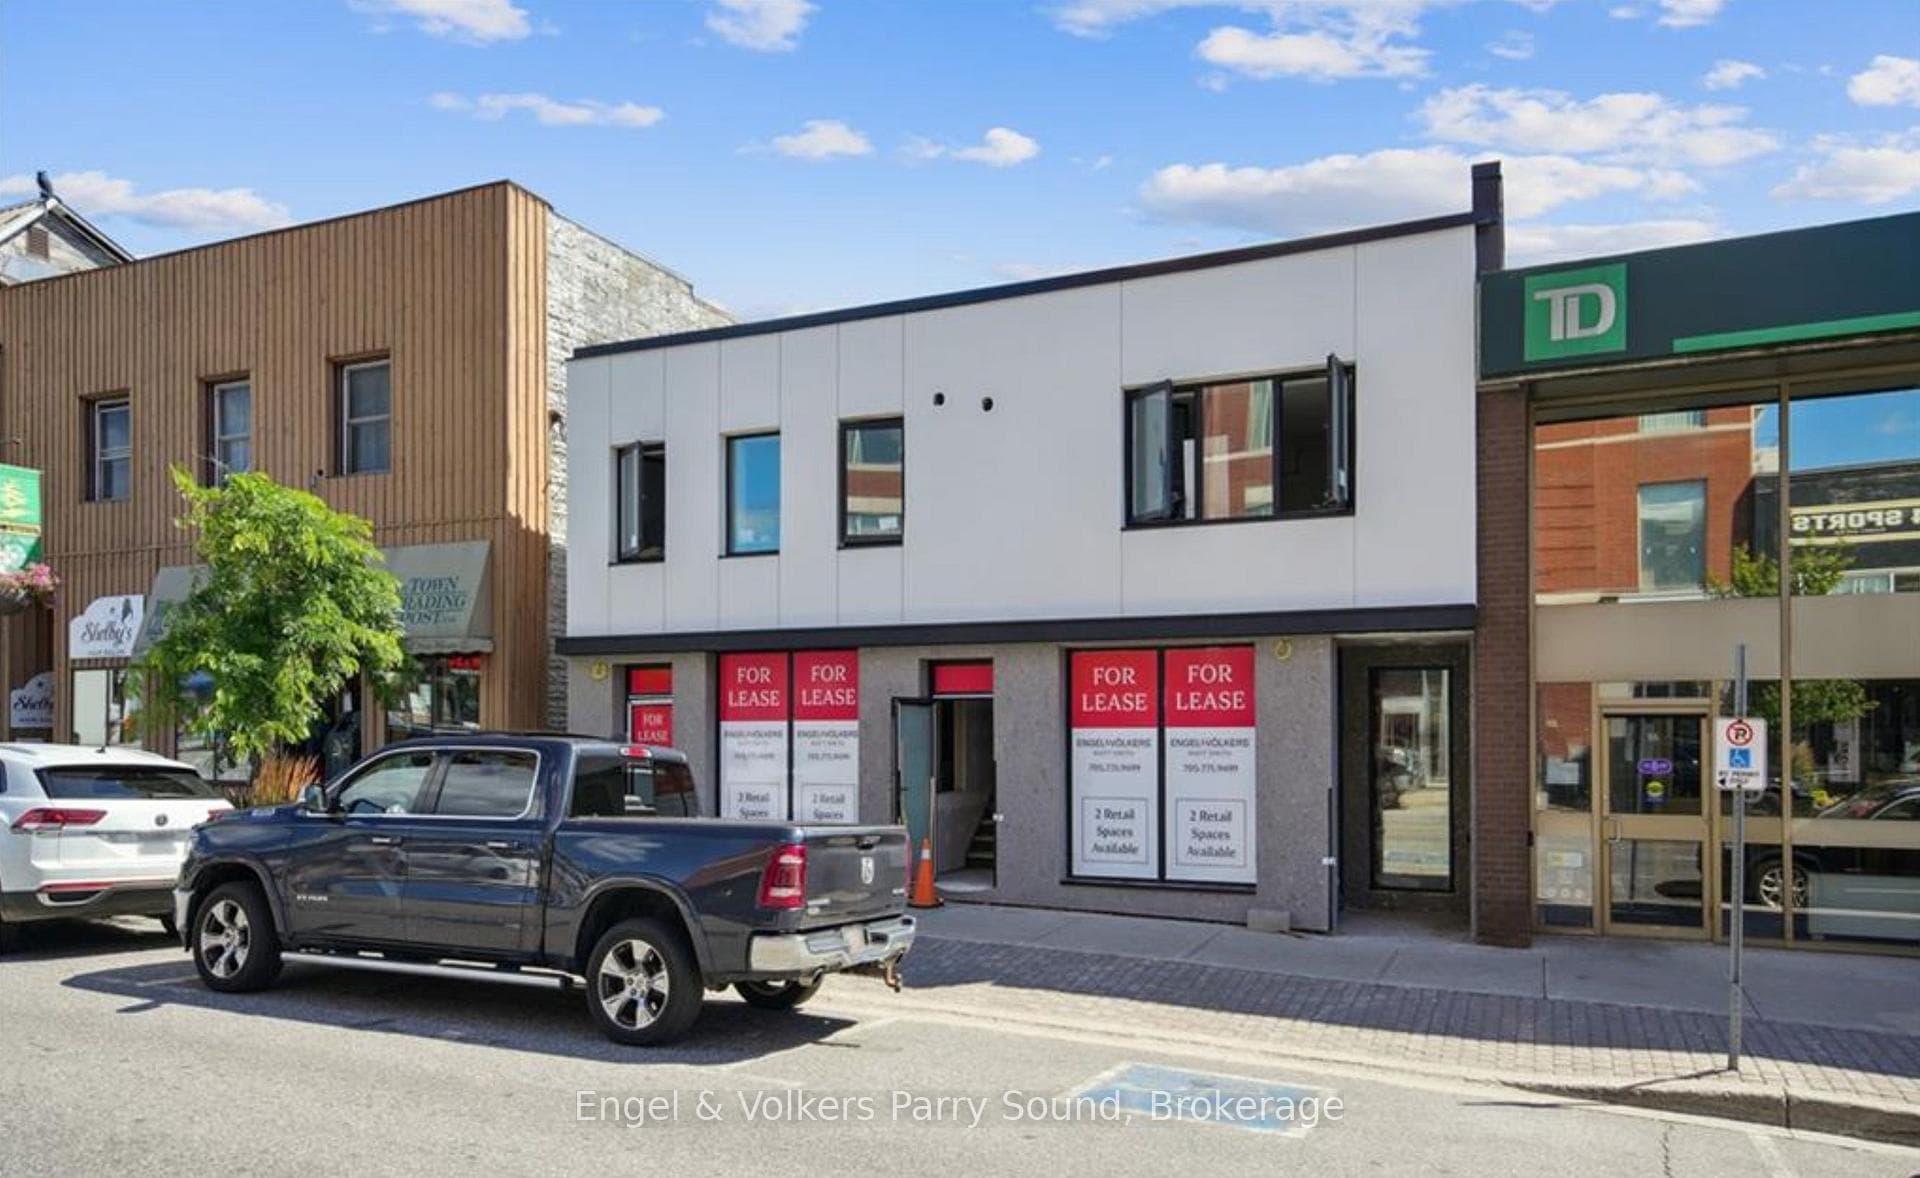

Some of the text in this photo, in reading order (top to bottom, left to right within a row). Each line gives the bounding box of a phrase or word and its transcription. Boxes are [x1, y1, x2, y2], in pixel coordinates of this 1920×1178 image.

[1534, 283, 1616, 342] TD
[408, 576, 459, 592] TOWN
[404, 592, 466, 609] RADING
[736, 666, 772, 684] FOR
[811, 665, 848, 682] FOR
[1093, 667, 1137, 686] FOR
[1188, 664, 1233, 684] FOR
[728, 690, 781, 708] LEASE
[801, 689, 857, 706] LEASE
[1082, 693, 1149, 712] LEASE
[1176, 691, 1246, 711] LEASE
[643, 713, 664, 725] FOR
[638, 730, 669, 742] LEASE
[746, 792, 770, 802] Retail
[820, 794, 846, 804] Retail
[740, 807, 769, 819] Spaces
[813, 808, 844, 819] Spaces
[1095, 808, 1136, 820] 2 Retail
[1190, 810, 1233, 822] 2 Retail
[1096, 826, 1134, 838] Spaces
[1190, 827, 1231, 841] Spaces
[1091, 843, 1139, 854] Available
[1186, 845, 1237, 857] Available
